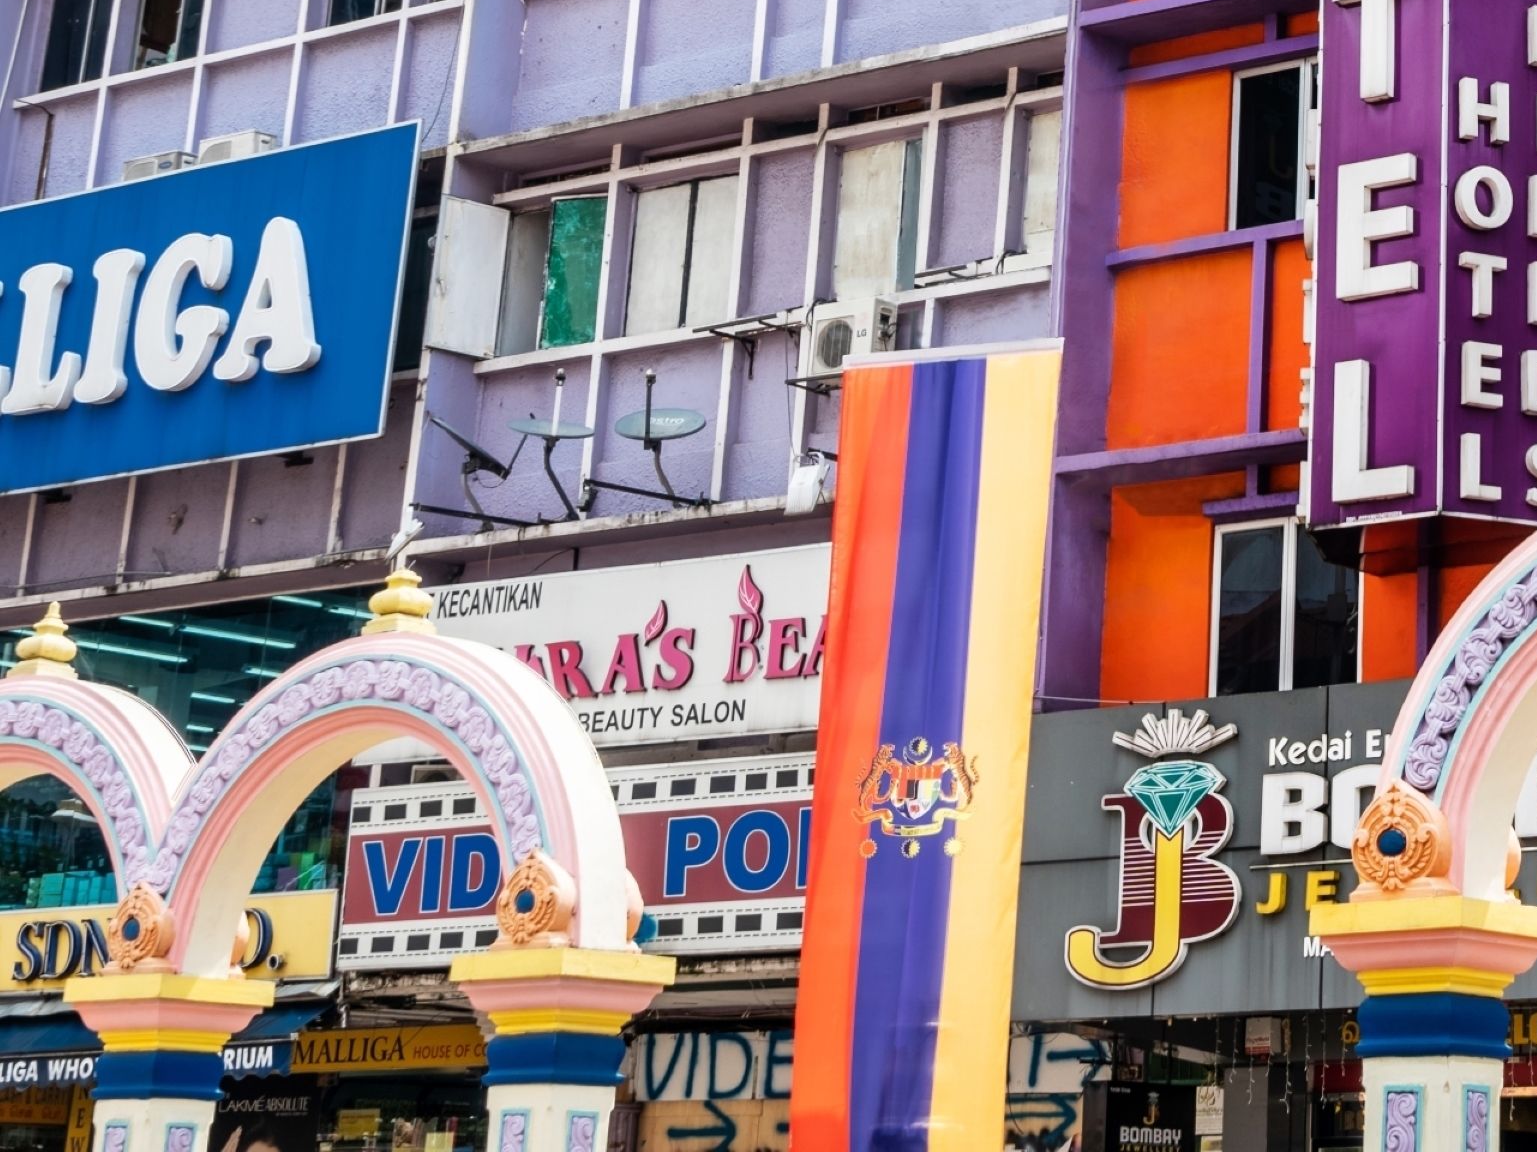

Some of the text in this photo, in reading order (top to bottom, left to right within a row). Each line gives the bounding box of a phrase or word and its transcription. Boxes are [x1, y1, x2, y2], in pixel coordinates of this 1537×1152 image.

[1455, 76, 1514, 503] HOTEL
[0, 215, 322, 417] LIGA
[437, 581, 543, 619] KECANTIKAN
[579, 699, 747, 734] BEAUTY SALON
[1269, 729, 1353, 767] Kedai
[218, 1045, 273, 1070] RIUM
[293, 1035, 405, 1065] MALLIGA
[413, 1045, 451, 1060] HOUSE
[454, 1044, 471, 1058] OF
[48, 1056, 100, 1081] WHO
[1120, 1126, 1182, 1145] BOMBAY
